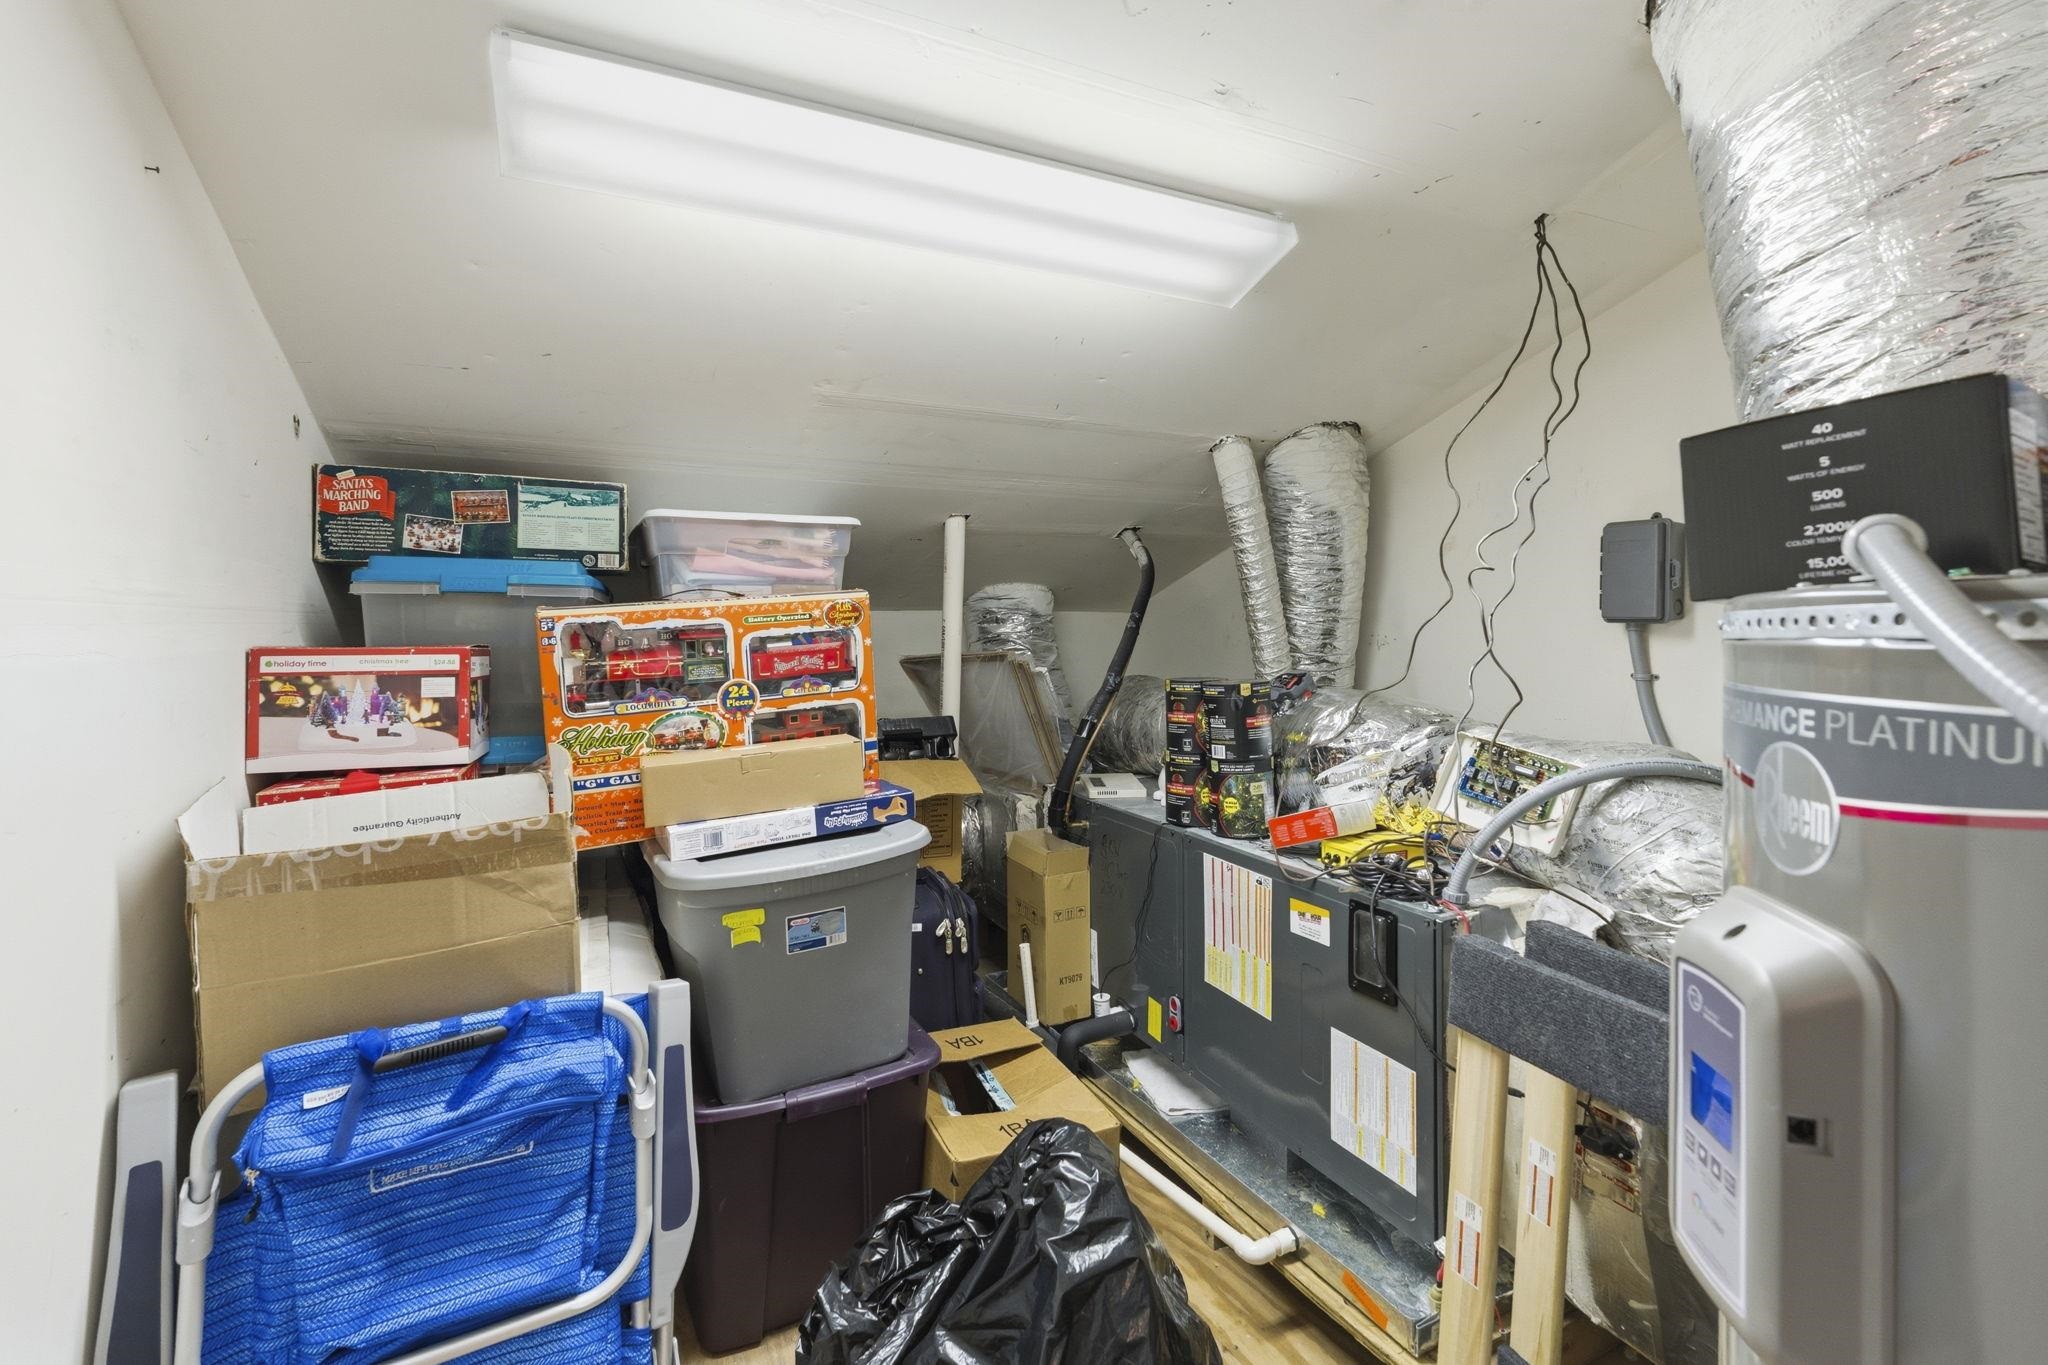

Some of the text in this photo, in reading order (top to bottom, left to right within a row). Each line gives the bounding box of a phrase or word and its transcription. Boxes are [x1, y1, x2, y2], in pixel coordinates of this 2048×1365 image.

[1811, 422, 1833, 434] 40
[1818, 455, 1831, 467] 5
[332, 478, 374, 490] SANTA'S
[323, 488, 381, 501] MARCHING
[1811, 487, 1843, 502] 500
[338, 499, 370, 512] BAND
[1785, 538, 1815, 548] COLOR
[1806, 555, 1849, 569] 15,00
[748, 613, 810, 623] Battery Operated
[273, 660, 306, 668] holiday
[728, 684, 750, 698] 24
[625, 700, 677, 712] LOCOMOTIVE
[726, 697, 754, 708] Pieces
[557, 723, 649, 756] Holiday
[609, 774, 641, 786] GAU
[352, 813, 462, 832] Authenticity Guarantee
[945, 1035, 984, 1050] 1BA
